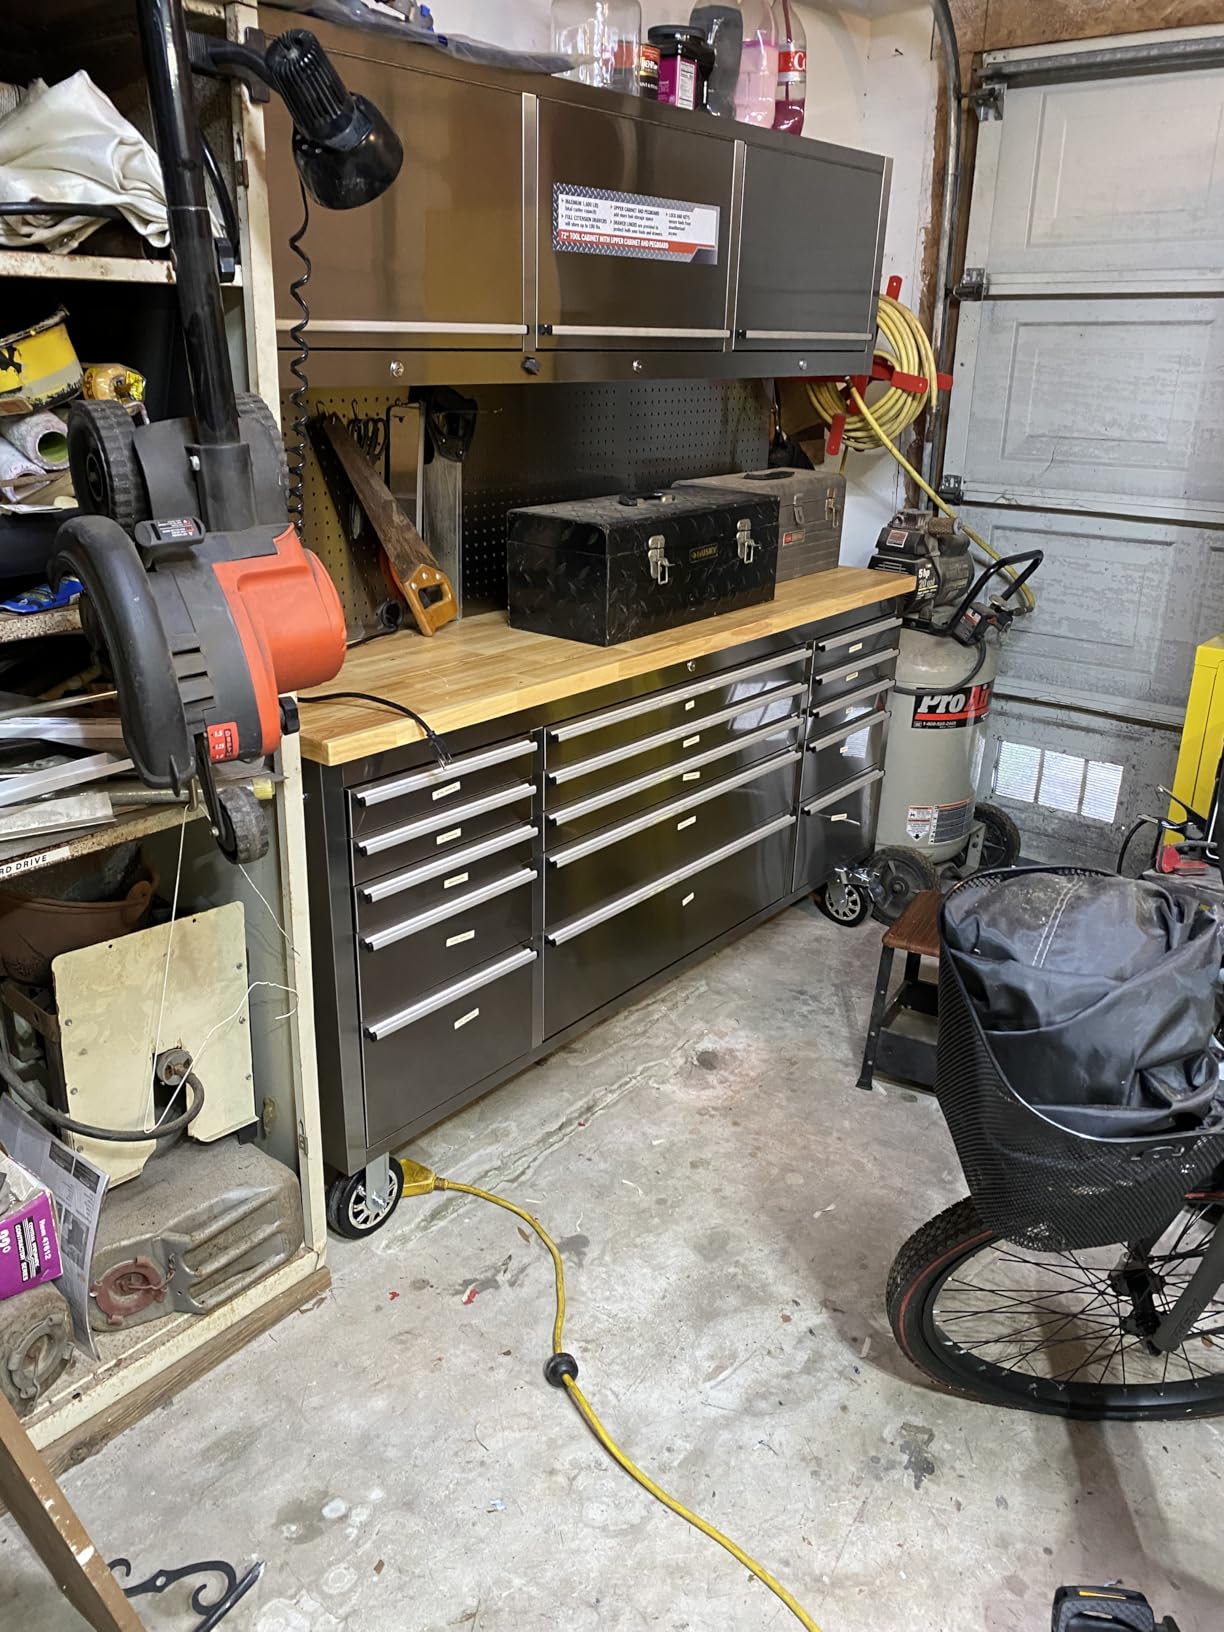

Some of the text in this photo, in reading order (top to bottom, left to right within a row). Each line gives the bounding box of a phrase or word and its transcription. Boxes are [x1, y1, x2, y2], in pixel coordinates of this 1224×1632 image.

[570, 232, 580, 241] TOOL
[581, 233, 599, 243] CABINET
[600, 235, 611, 243] WITH
[611, 236, 624, 245] UPPER
[624, 238, 640, 247] CABINET
[697, 546, 717, 557] HUSKY
[918, 693, 965, 713] Pro
[16, 855, 47, 870] DRIVE
[15, 1225, 29, 1281] CONTRACTOR SERIES
